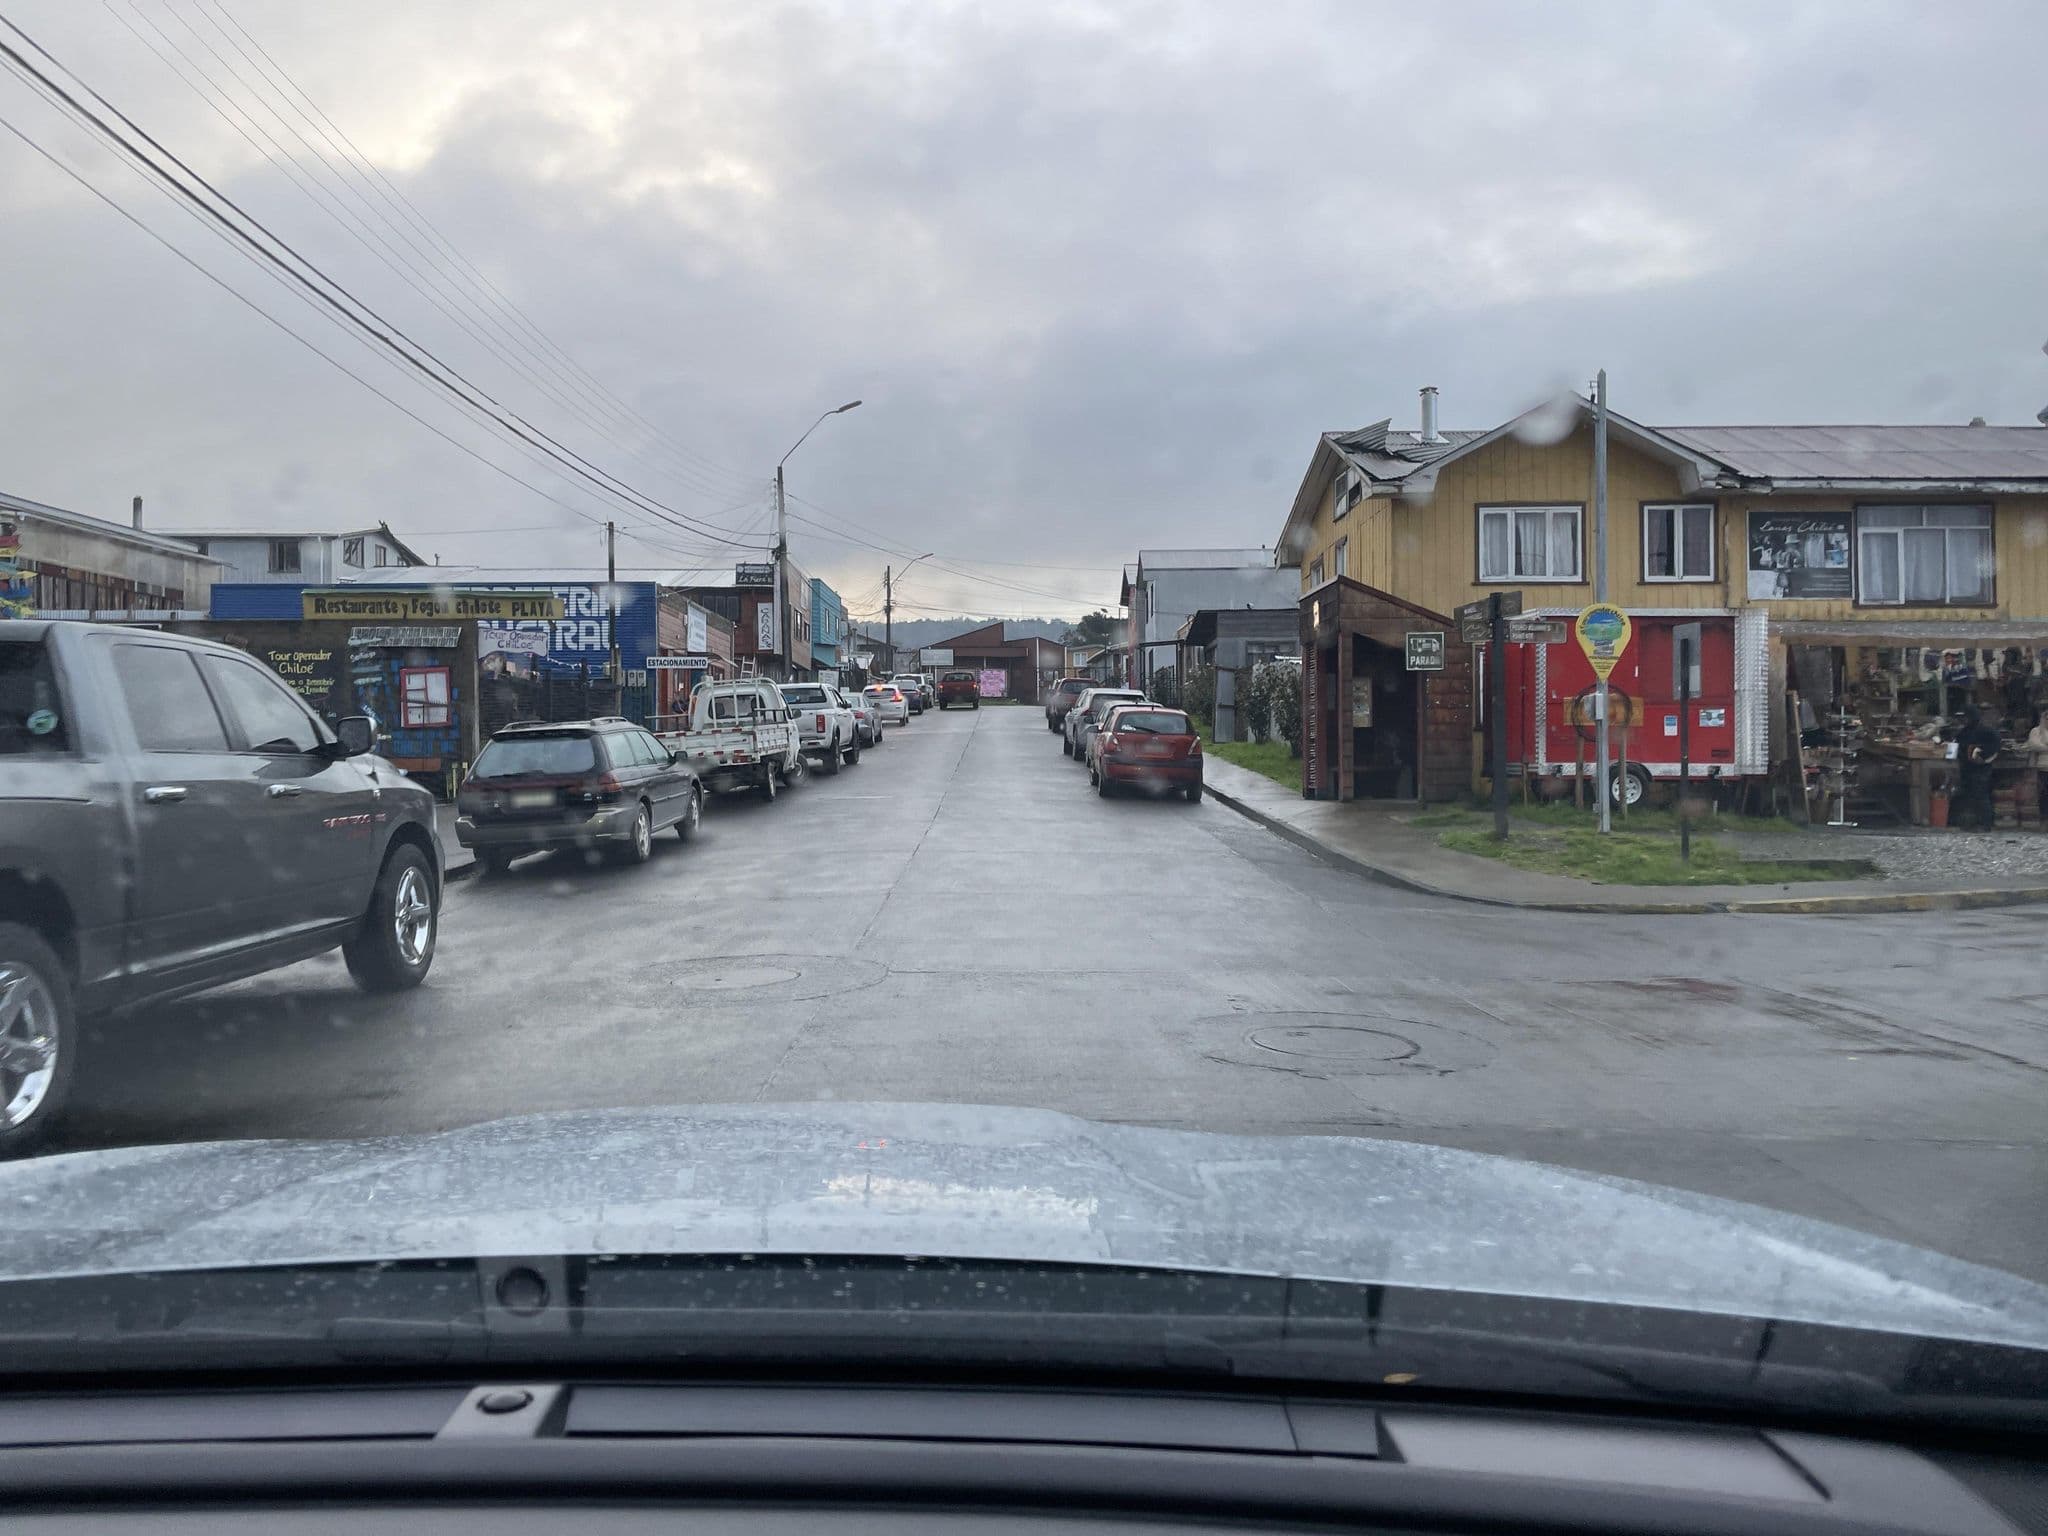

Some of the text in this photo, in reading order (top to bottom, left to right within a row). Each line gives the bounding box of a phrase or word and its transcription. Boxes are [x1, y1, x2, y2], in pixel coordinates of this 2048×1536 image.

[314, 598, 399, 614] Restaurante
[401, 602, 409, 619] y
[511, 600, 554, 617] PLAYA
[267, 650, 292, 661] Tour
[647, 658, 707, 667] ESTACIONAMIENTO
